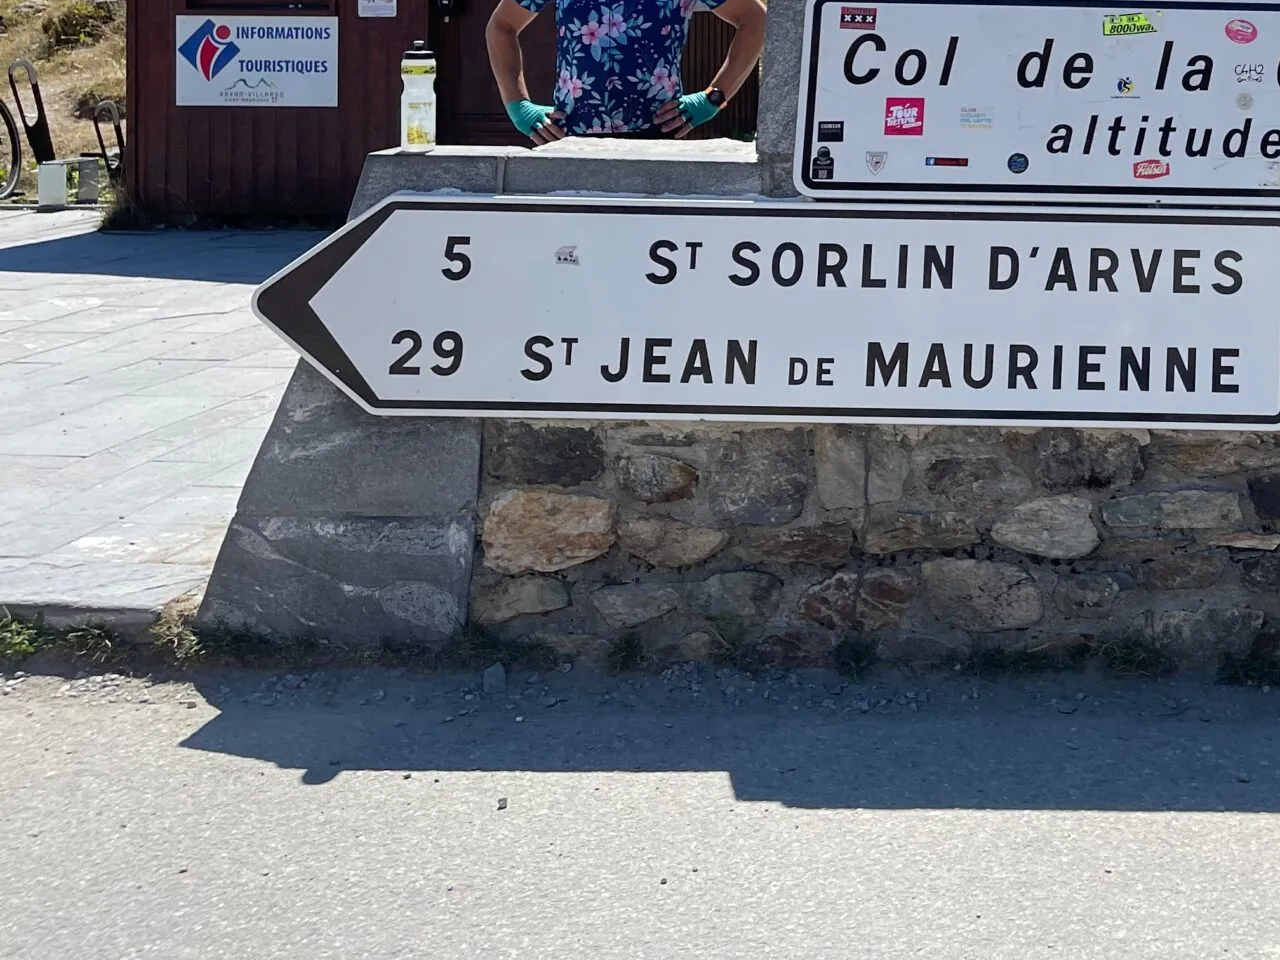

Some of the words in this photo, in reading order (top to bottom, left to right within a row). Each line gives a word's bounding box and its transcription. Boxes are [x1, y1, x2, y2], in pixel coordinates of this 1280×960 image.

[236, 26, 331, 40] INFORMATIONS
[238, 59, 328, 74] TOURISTIQUES
[843, 33, 960, 86] Col
[1016, 38, 1094, 90] de
[1154, 40, 1214, 92] la
[441, 236, 472, 281] 5
[728, 241, 955, 290] SORLIN
[988, 245, 1243, 295] D'ARVES
[388, 329, 464, 377] 29
[600, 337, 758, 385] JEAN
[788, 357, 835, 386] DE
[865, 341, 1240, 394] MAURIENNE
